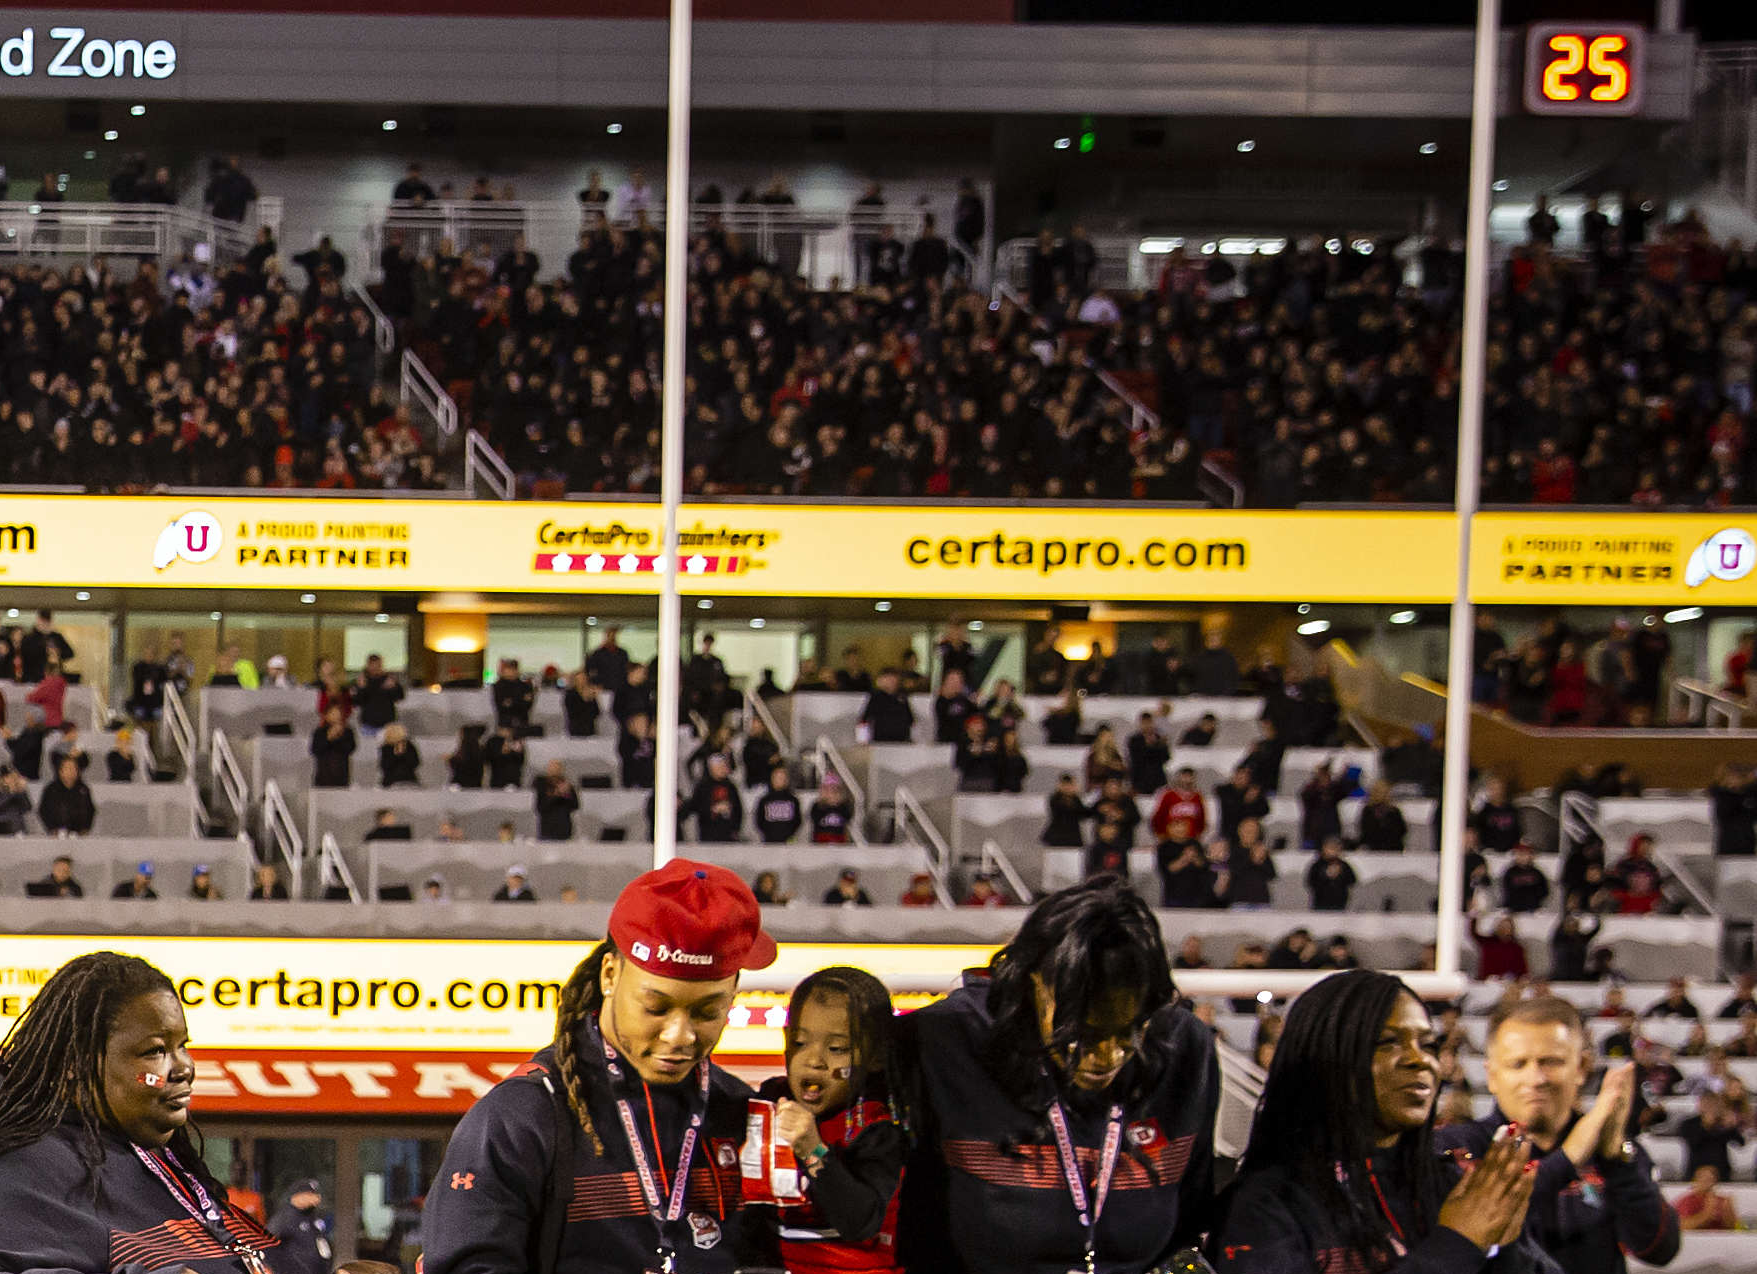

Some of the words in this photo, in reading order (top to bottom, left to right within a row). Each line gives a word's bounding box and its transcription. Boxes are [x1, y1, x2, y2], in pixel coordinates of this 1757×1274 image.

[46, 26, 177, 79] Zone
[1542, 34, 1630, 101] 25
[184, 525, 210, 552] U
[239, 548, 407, 566] PARTNER
[907, 533, 1246, 573] certapro.com
[179, 970, 562, 1017] certapro.com
